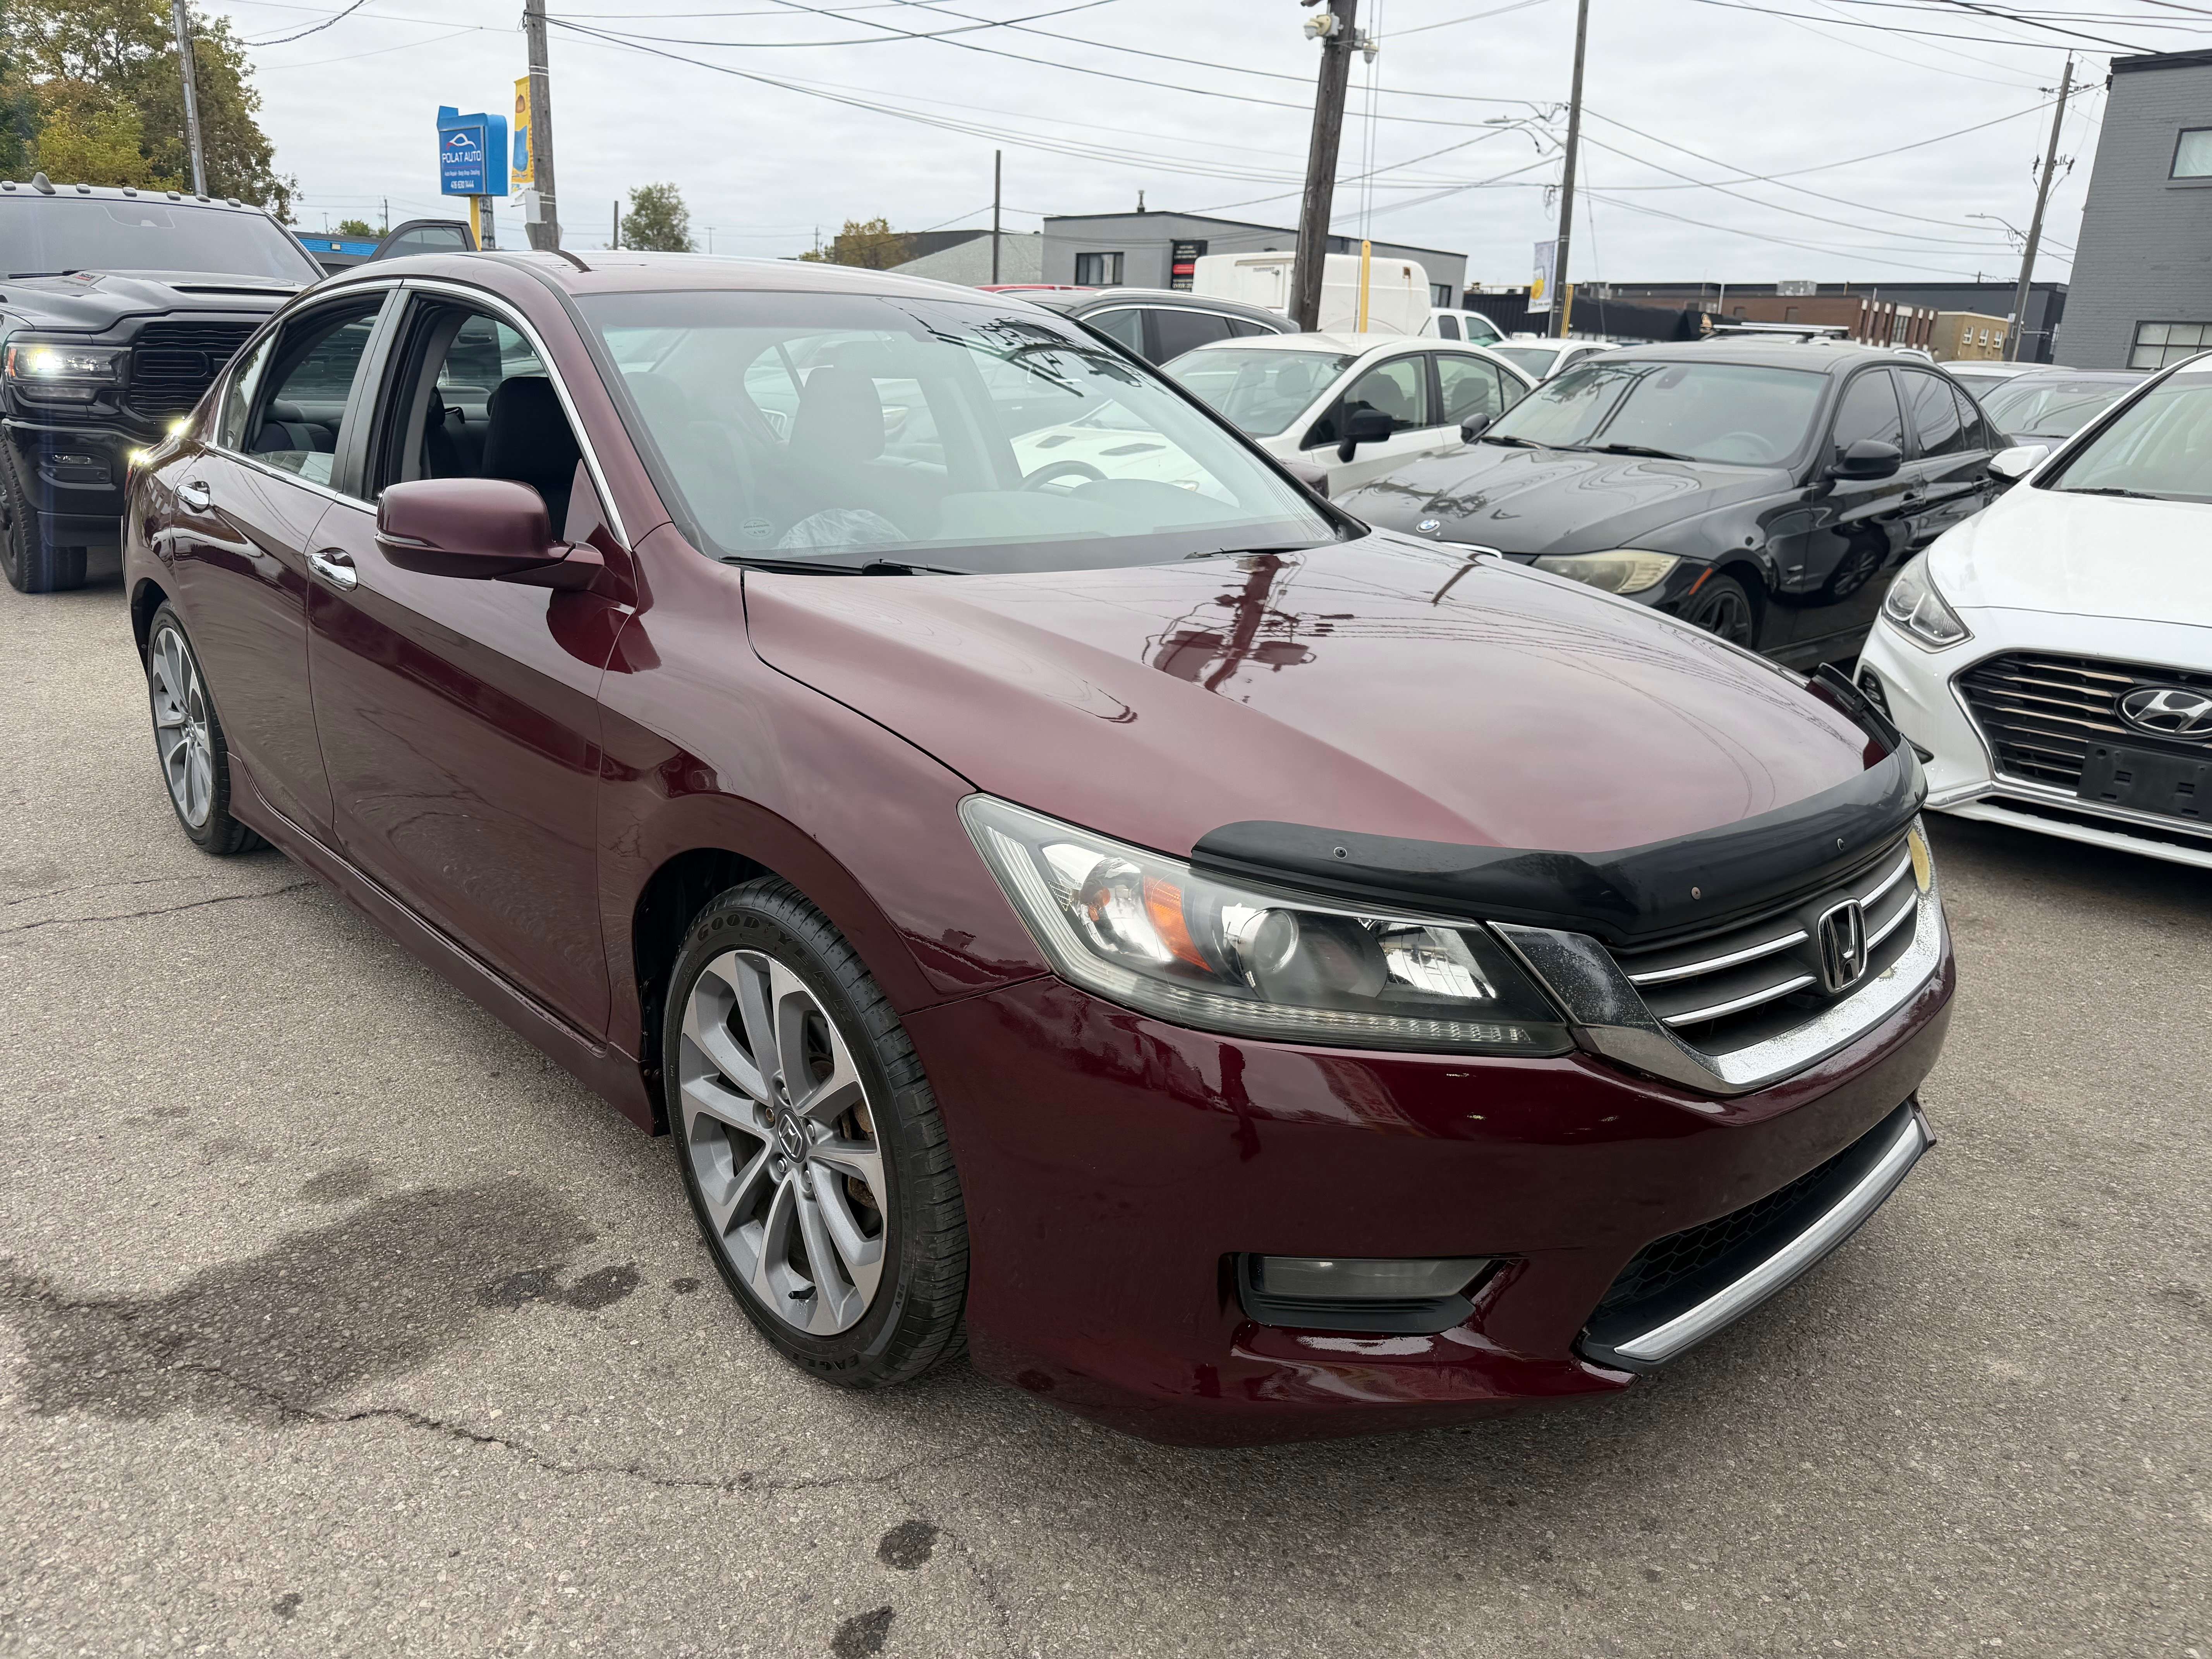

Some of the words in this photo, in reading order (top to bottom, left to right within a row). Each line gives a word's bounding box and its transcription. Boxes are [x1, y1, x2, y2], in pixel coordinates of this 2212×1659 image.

[442, 152, 463, 163] POLAT
[464, 150, 481, 162] AUTO
[697, 914, 760, 942] GOOD
[778, 929, 852, 1023] YEAR
[788, 1348, 859, 1371] EAGLE
